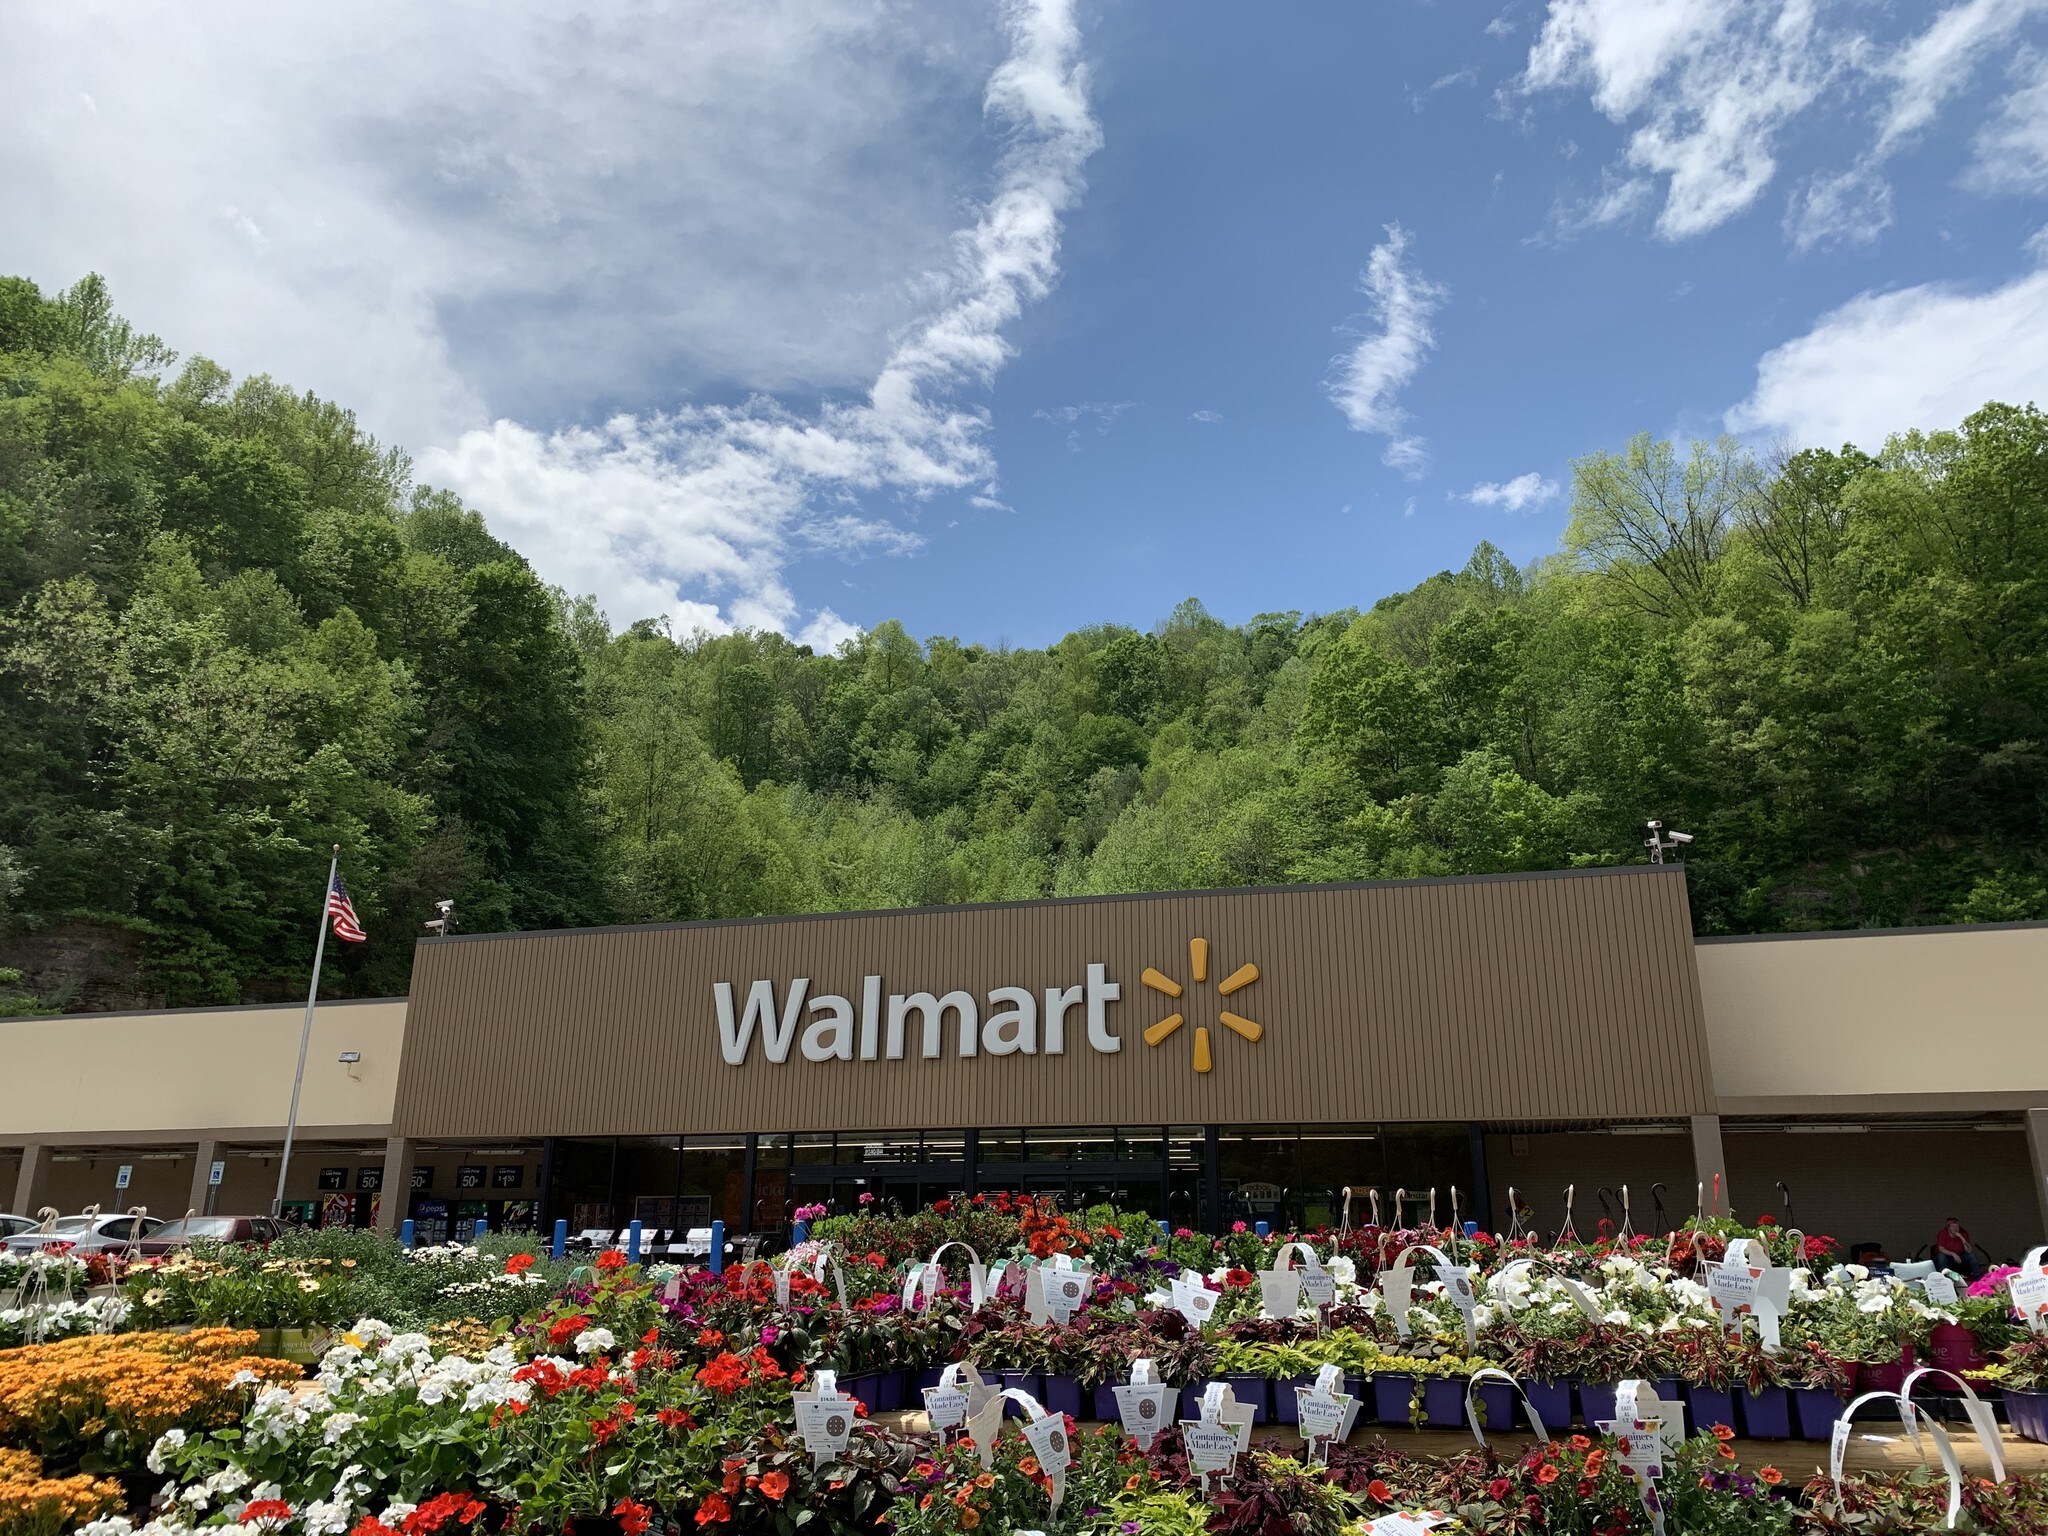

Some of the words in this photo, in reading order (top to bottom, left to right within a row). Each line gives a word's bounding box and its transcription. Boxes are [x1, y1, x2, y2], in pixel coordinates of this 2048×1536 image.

[713, 963, 1121, 1066] Walmart
[426, 1205, 446, 1213] pepsi
[1525, 1208, 1531, 1216] 2
[1712, 1271, 1754, 1283] Containers
[1713, 1279, 1734, 1288] Made
[1735, 1281, 1752, 1293] Easy
[930, 1393, 965, 1402] Containers
[930, 1401, 949, 1409] Made
[949, 1401, 964, 1410] Easy
[1303, 1398, 1341, 1410] Containers
[1303, 1406, 1322, 1416] Made
[1323, 1409, 1339, 1420] Easy
[1190, 1432, 1233, 1441] Containers
[1191, 1441, 1214, 1449] Made
[1214, 1441, 1232, 1453] Easy
[1634, 1441, 1654, 1452] Easy
